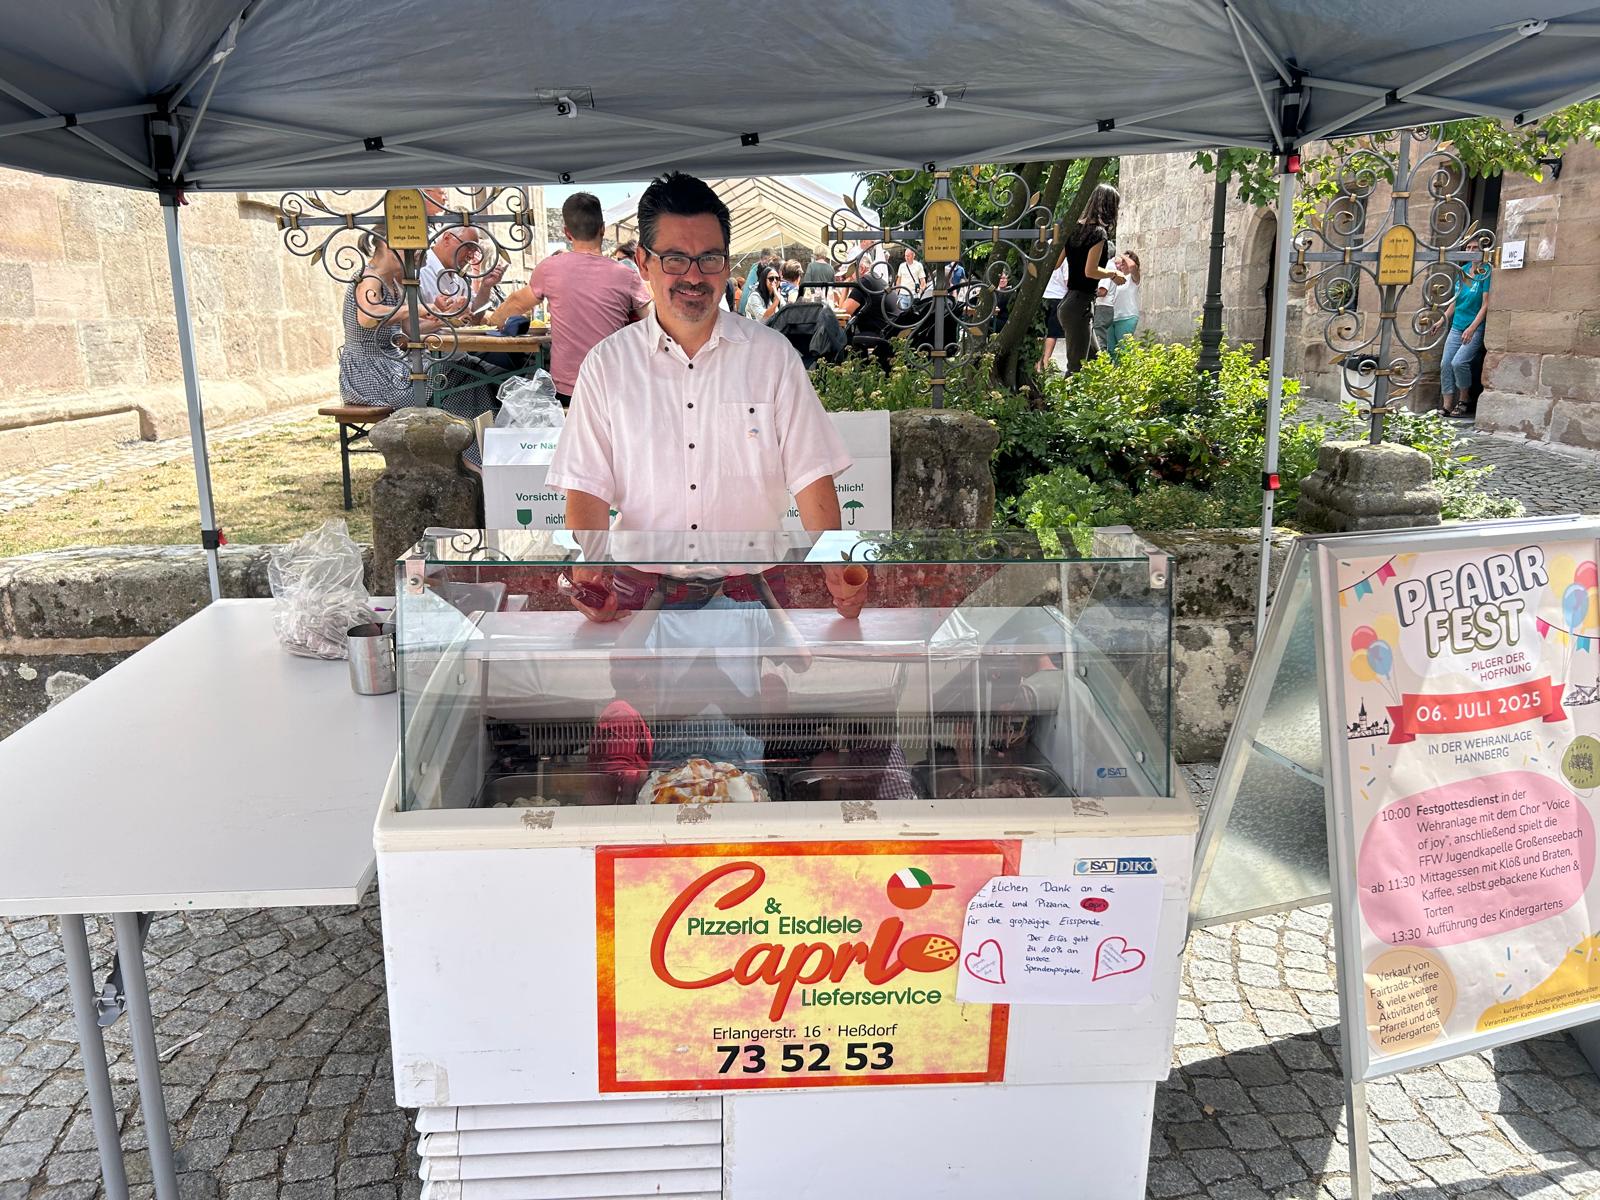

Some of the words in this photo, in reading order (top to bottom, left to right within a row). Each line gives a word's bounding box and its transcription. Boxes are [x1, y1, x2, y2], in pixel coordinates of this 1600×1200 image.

[519, 442, 538, 450] Vor
[515, 492, 558, 502] Vorsicht
[1394, 545, 1549, 628] PFARR
[1424, 598, 1526, 659] FEST
[1471, 656, 1504, 672] PILGER
[1505, 651, 1526, 664] DER
[1480, 662, 1532, 682] HOFFNUNG
[1416, 704, 1447, 722] 06.
[1454, 700, 1491, 720] JULI
[1498, 691, 1542, 714] 2025
[1428, 743, 1439, 755] IN
[1441, 741, 1463, 754] DER
[1464, 730, 1533, 750] WEHRANLAGE
[1455, 746, 1510, 765] HANNBERG
[1382, 806, 1411, 822] 10:00
[1416, 793, 1499, 817] Festgottesdienst
[1501, 792, 1510, 802] in
[1511, 789, 1527, 801] der
[1416, 816, 1477, 833] Wehranlage
[1479, 811, 1495, 822] mit
[1496, 809, 1517, 820] dem
[1520, 803, 1540, 816] Chor
[1418, 838, 1430, 850] of
[1454, 824, 1516, 845] anschließend
[1518, 819, 1542, 833] spielt
[1544, 817, 1558, 828] die
[1419, 852, 1443, 868] FFW
[1445, 842, 1514, 863] Jugendkapelle
[1515, 828, 1583, 850] Großenseebach
[1090, 860, 1109, 871] ISA
[1371, 882, 1385, 894] ab
[1388, 875, 1416, 891] 11:30
[1420, 866, 1480, 885] Mittagessen
[1481, 862, 1498, 873] mit
[1499, 856, 1521, 869] Klöß
[1523, 852, 1540, 865] und
[992, 881, 1029, 893] zlichen
[1040, 881, 1071, 893] Dank
[1100, 883, 1115, 893] die
[1421, 887, 1455, 902] Kaffee,
[1456, 880, 1486, 895] selbst
[1488, 871, 1538, 891] gebackene
[1539, 863, 1571, 879] Kuchen
[1572, 860, 1580, 871] &
[764, 897, 782, 915] &
[969, 900, 1006, 911] Eisdiele
[1424, 905, 1454, 919] Torten
[687, 916, 769, 936] Pizzeria
[778, 915, 863, 935] Eisdiele
[967, 914, 980, 927] für
[987, 916, 1002, 925] die
[1391, 927, 1421, 944] 13:30
[1426, 916, 1478, 937] Aufführung
[1480, 913, 1497, 924] des
[1499, 899, 1564, 920] Kindergartens
[650, 861, 908, 1022] Capri
[1376, 964, 1412, 982] Verkauf
[1413, 961, 1430, 972] von
[801, 987, 942, 1007] Lieferservice
[1370, 971, 1440, 999] Fairtrade-Kaffee
[1376, 1000, 1385, 1010] &
[1386, 994, 1407, 1008] viele
[1407, 983, 1438, 1000] weitere
[1379, 1001, 1424, 1023] Aktivitäten
[1425, 996, 1439, 1007] der
[1379, 1017, 1408, 1035] Pfarrei
[1409, 1012, 1425, 1025] und
[1426, 1008, 1441, 1019] des
[712, 1026, 797, 1042] Erlangerstr.
[803, 1025, 822, 1038] 16
[838, 1023, 899, 1038] Heßdorf
[1380, 1020, 1440, 1046] Kindergartens
[716, 1044, 767, 1074] 73
[781, 1042, 832, 1073] 52
[844, 1041, 895, 1072] 53
